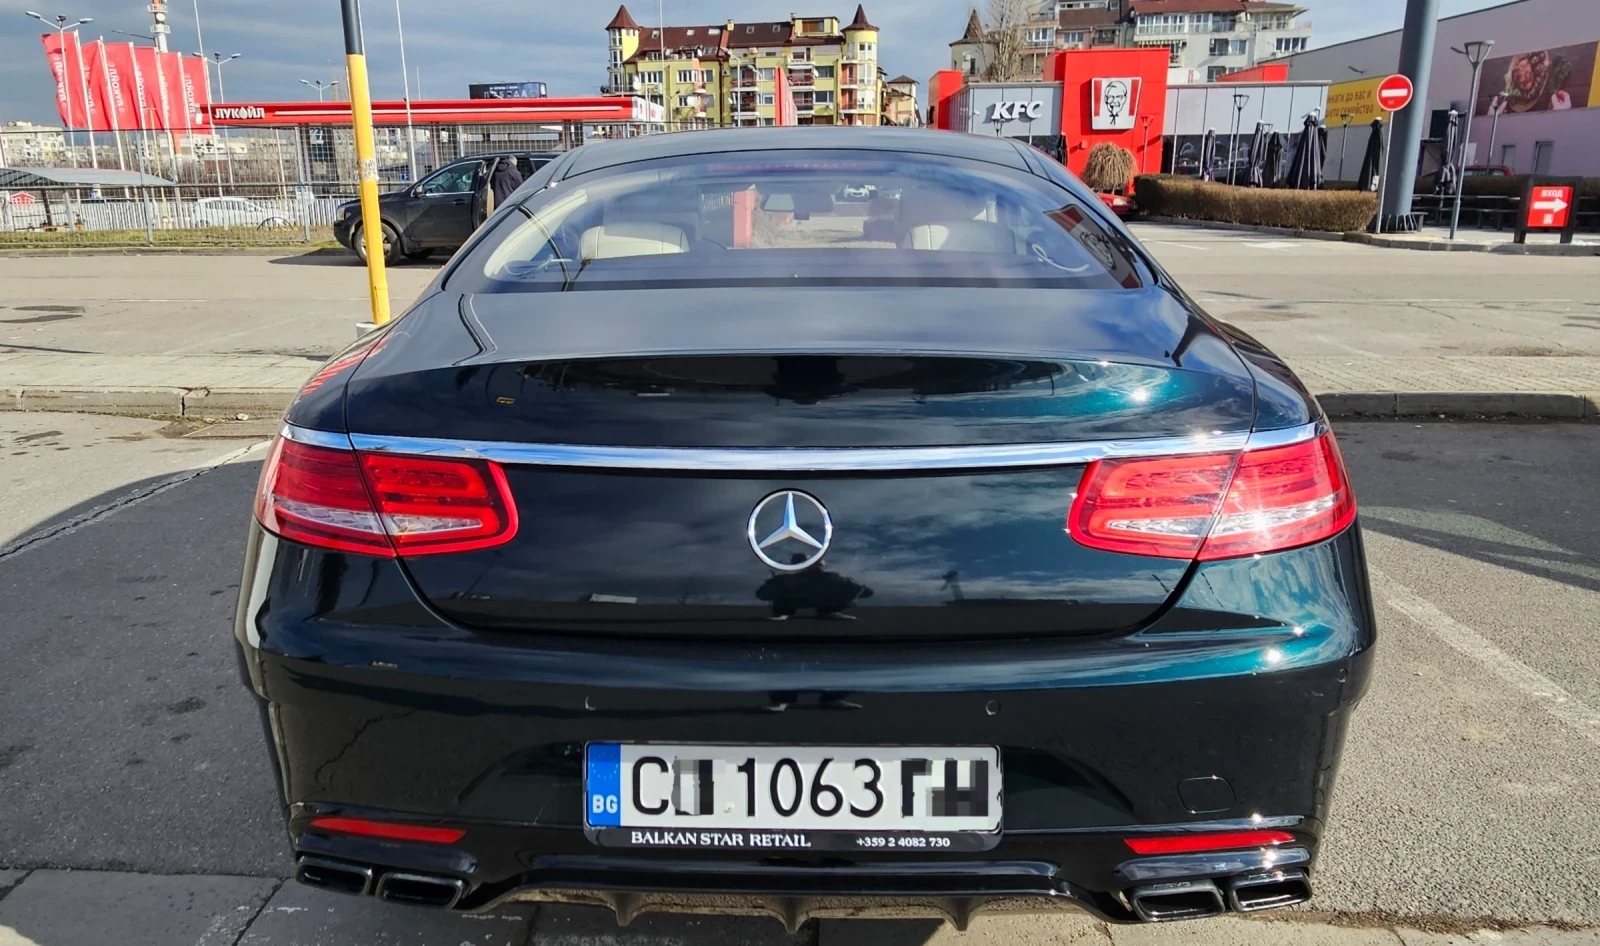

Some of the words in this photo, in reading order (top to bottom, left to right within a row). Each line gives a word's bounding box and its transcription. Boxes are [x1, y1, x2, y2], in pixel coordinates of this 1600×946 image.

[215, 105, 266, 119] ЛУКОЙЛ
[992, 101, 1044, 120] KFC
[1541, 189, 1563, 198] ВХОД
[737, 757, 885, 818] 1063
[592, 795, 618, 814] BG
[631, 831, 698, 846] BALKAN
[700, 832, 744, 847] STAR
[749, 833, 812, 848] RETAIL
[856, 836, 886, 848] +359
[888, 837, 896, 848] 2
[898, 836, 926, 848] 4082
[928, 836, 951, 848] 730
